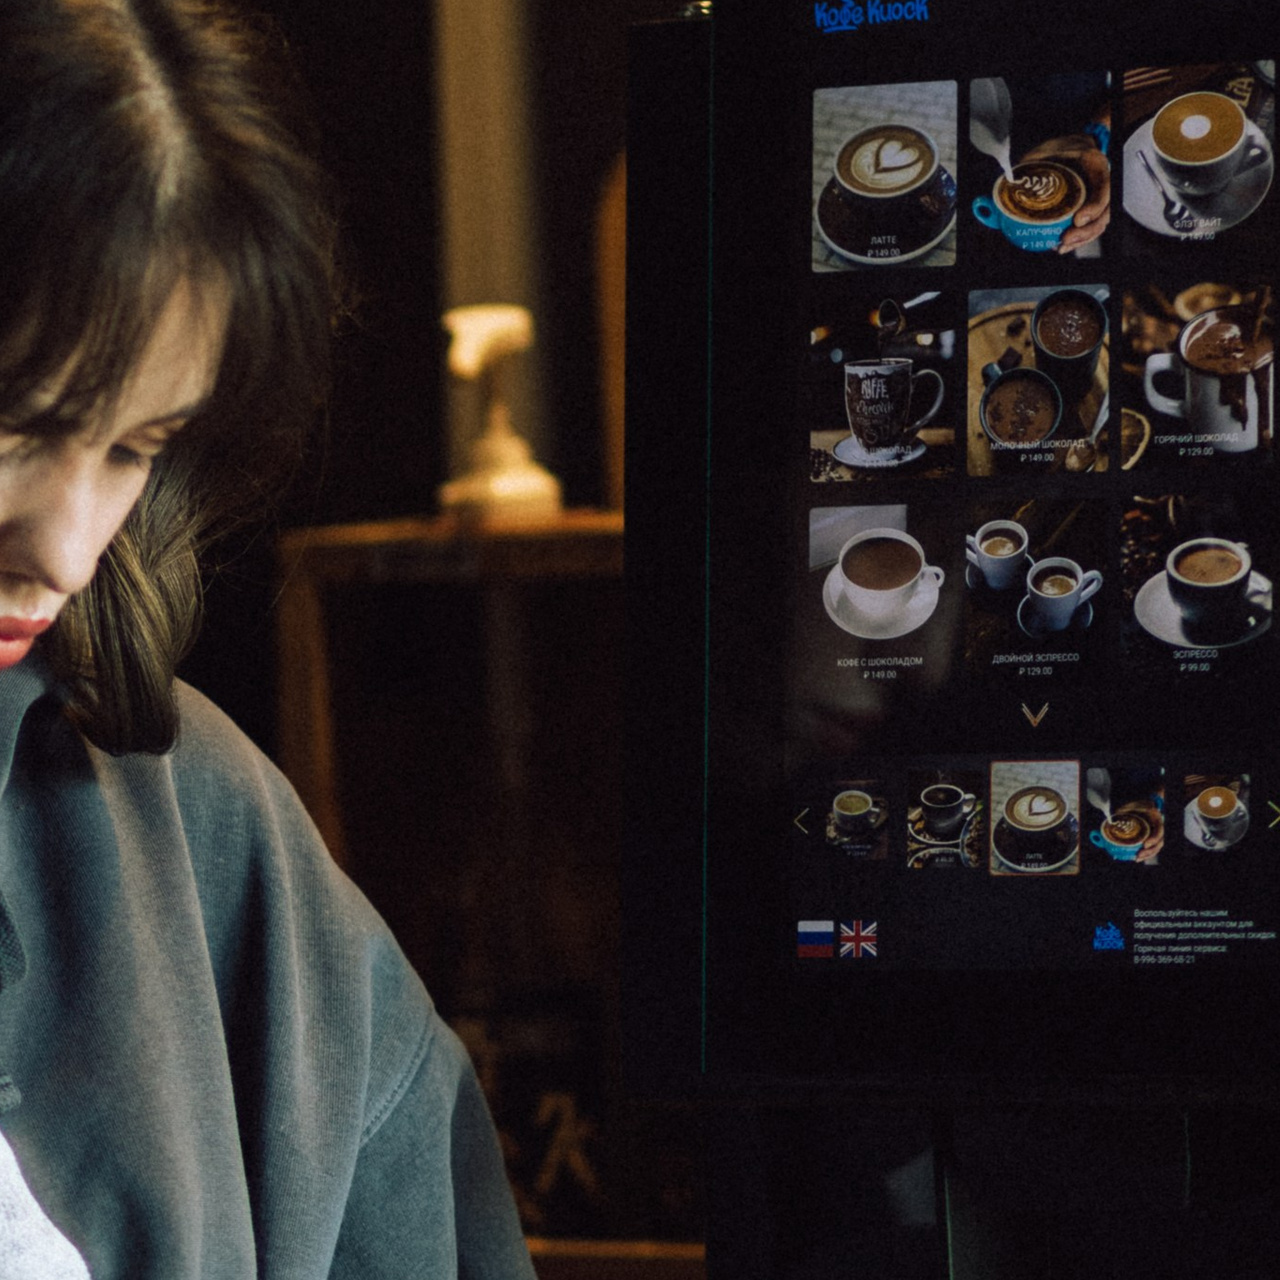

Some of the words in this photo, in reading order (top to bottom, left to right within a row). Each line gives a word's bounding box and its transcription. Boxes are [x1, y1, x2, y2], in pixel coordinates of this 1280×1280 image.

[871, 236, 897, 246] ЛАТТЕ
[875, 248, 901, 257] 149.00
[1154, 434, 1193, 445] ГОРЯЧИЙ
[1195, 433, 1239, 443] ШОКОЛАД
[990, 440, 1042, 451] МОЛОЧНЫЙ
[1042, 439, 1086, 449] ШОКОЛАД
[1187, 447, 1213, 456] 129.00
[1028, 453, 1055, 462] 149.00
[992, 653, 1034, 664] ДВОЙНОЙ
[1035, 652, 1080, 662] ЭСПРЕССО
[1173, 650, 1218, 659] ЭСПРЕССО
[837, 658, 860, 667] КОФЕ
[868, 657, 923, 667] ШОКОЛАДОМ
[1026, 666, 1052, 675] 129.00
[1188, 663, 1210, 672] 99.00
[871, 670, 897, 679] 149.00
[1134, 909, 1198, 919] Воспользуйтесь
[1200, 909, 1228, 917] нашим
[1134, 920, 1192, 929] официальным
[1193, 921, 1237, 929] аккаунтом
[1134, 932, 1177, 941] получения
[1177, 932, 1246, 940] дополнительных
[1134, 944, 1167, 953] Горячая
[1168, 945, 1192, 953] линия
